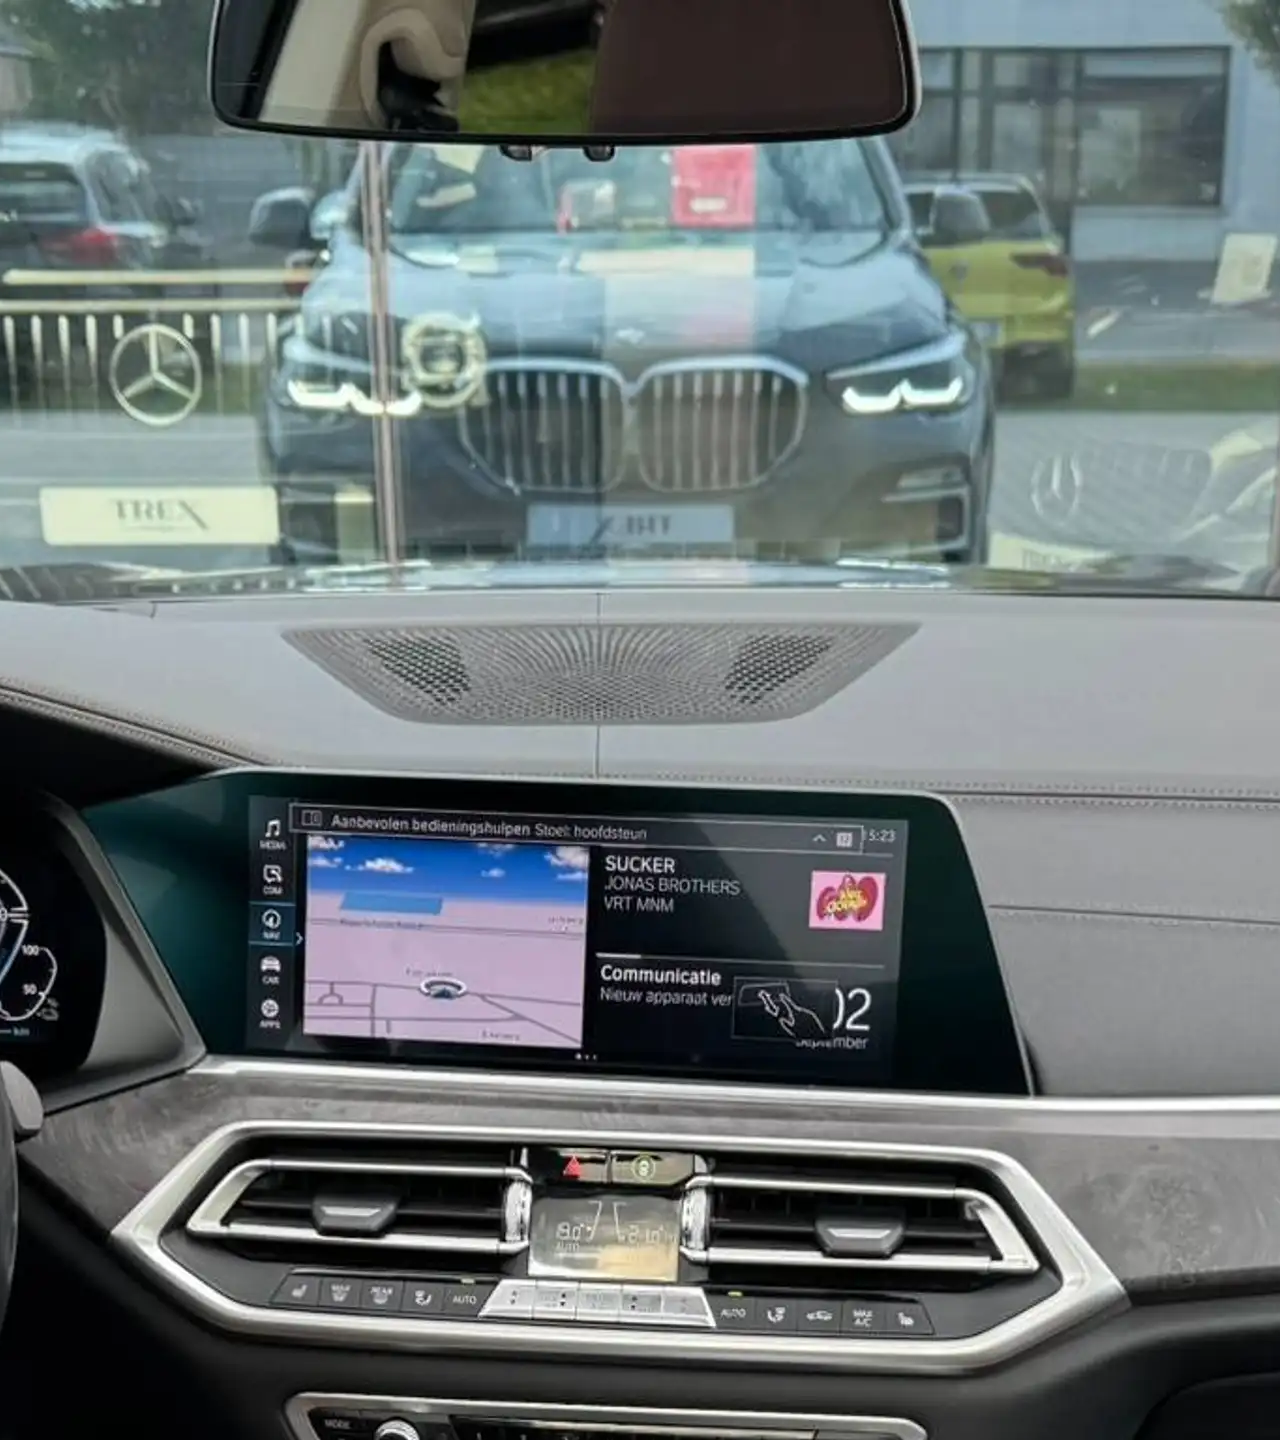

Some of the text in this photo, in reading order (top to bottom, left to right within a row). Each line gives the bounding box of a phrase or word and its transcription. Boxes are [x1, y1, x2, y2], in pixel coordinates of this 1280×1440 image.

[331, 814, 409, 831] Aanbevolen
[412, 818, 531, 837] bedieningshulpen
[573, 825, 647, 841] hoofdsteun
[605, 854, 676, 874] SUCKER
[604, 877, 741, 896] JONAS BROTHERS
[604, 896, 675, 914] VRT MNM
[600, 964, 722, 986] Communicatie
[599, 986, 644, 1003] Nieuw
[645, 989, 708, 1007] apparaat
[452, 1295, 477, 1305] AUTO
